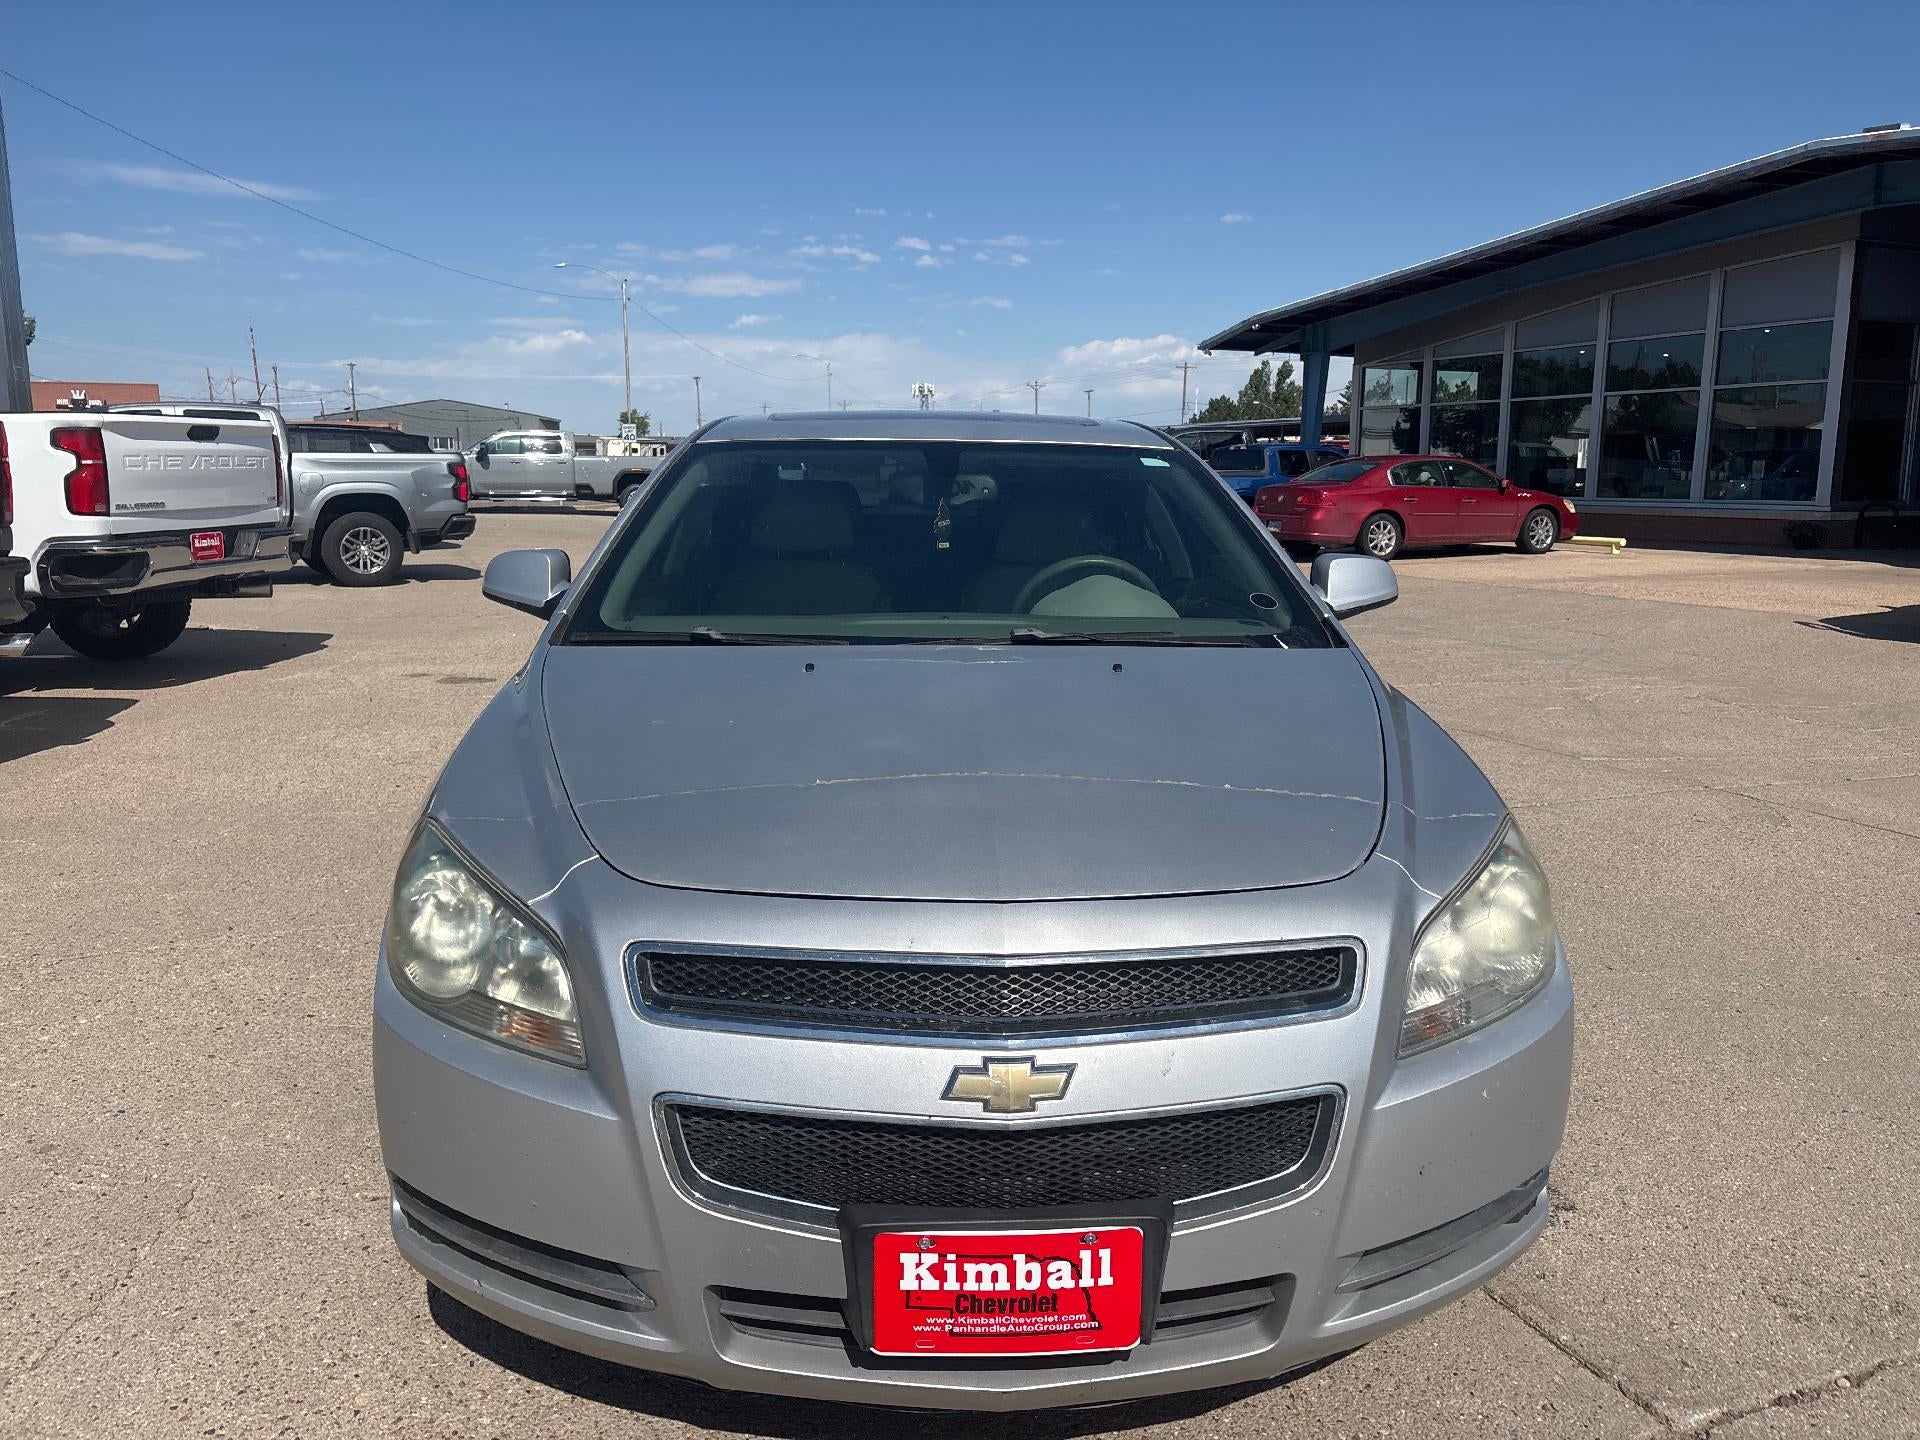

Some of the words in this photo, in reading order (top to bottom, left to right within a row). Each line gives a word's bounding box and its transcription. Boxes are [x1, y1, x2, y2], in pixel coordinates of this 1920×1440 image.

[624, 433, 636, 441] 40
[123, 454, 269, 471] CHEVROLET
[899, 1248, 1114, 1291] Kimball
[954, 1293, 1058, 1315] Chevrolet
[926, 1313, 1087, 1325] www.KimballChevrolet.com
[913, 1320, 1099, 1334] www.PanhandleAutoGroup.com
